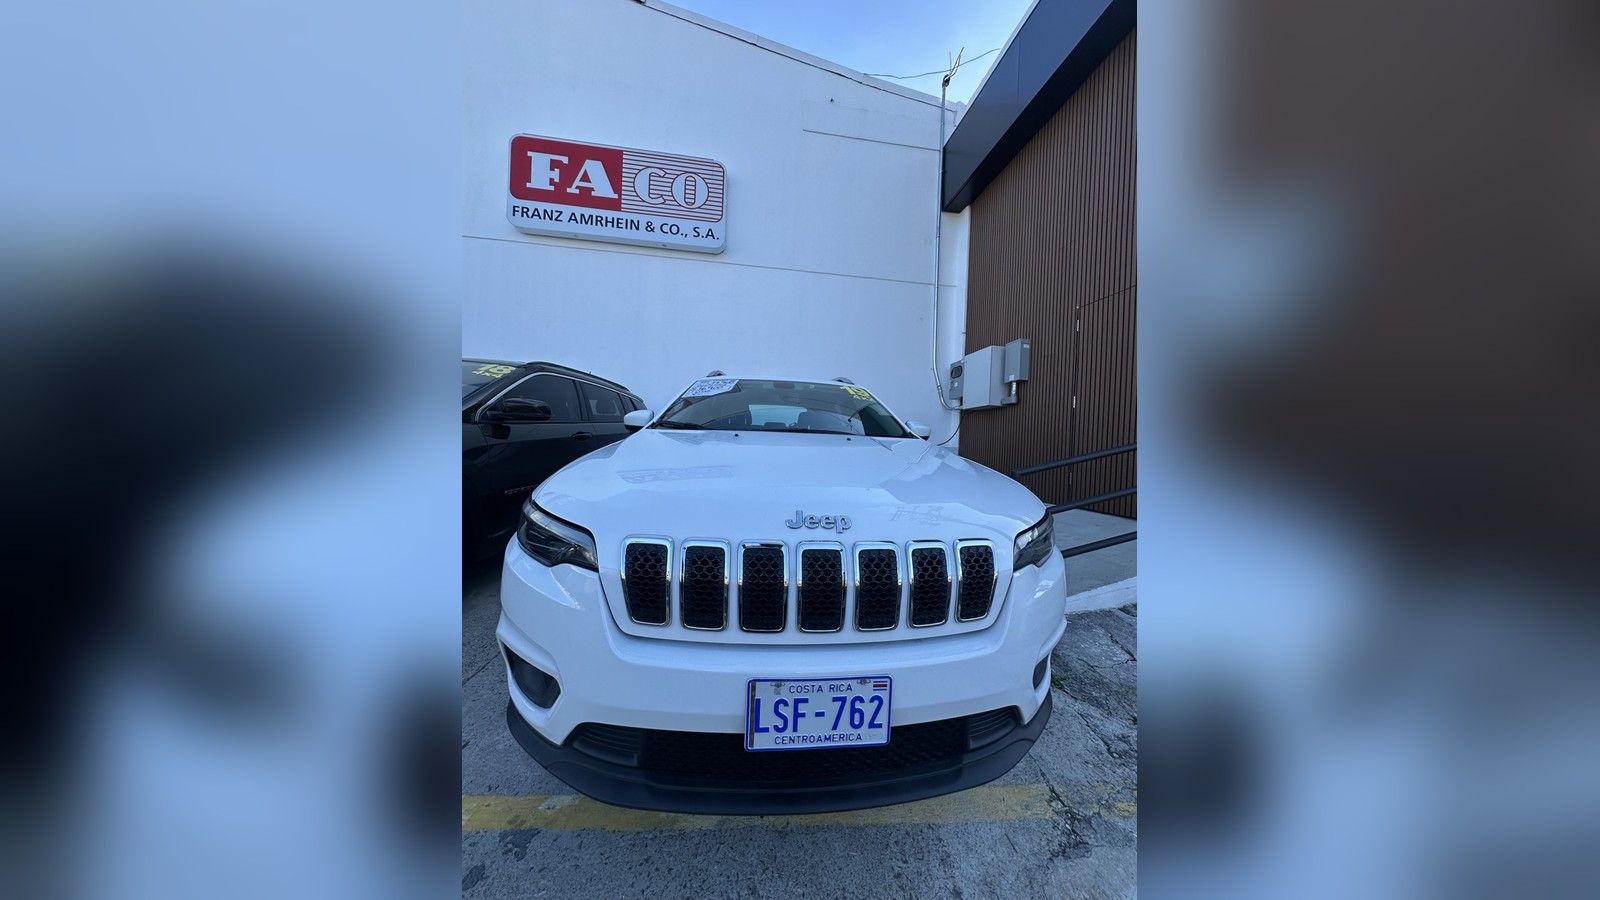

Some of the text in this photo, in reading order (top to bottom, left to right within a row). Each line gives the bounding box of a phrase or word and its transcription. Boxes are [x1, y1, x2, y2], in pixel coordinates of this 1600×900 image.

[526, 151, 709, 209] FACO
[512, 205, 720, 241] FRANZ AMRHEIN & CO., S.A.
[785, 510, 852, 534] Jeep
[789, 684, 824, 694] COSTA
[829, 683, 853, 693] RICA
[754, 694, 884, 733] LSF-762
[774, 733, 863, 745] CENTROAMERICA
